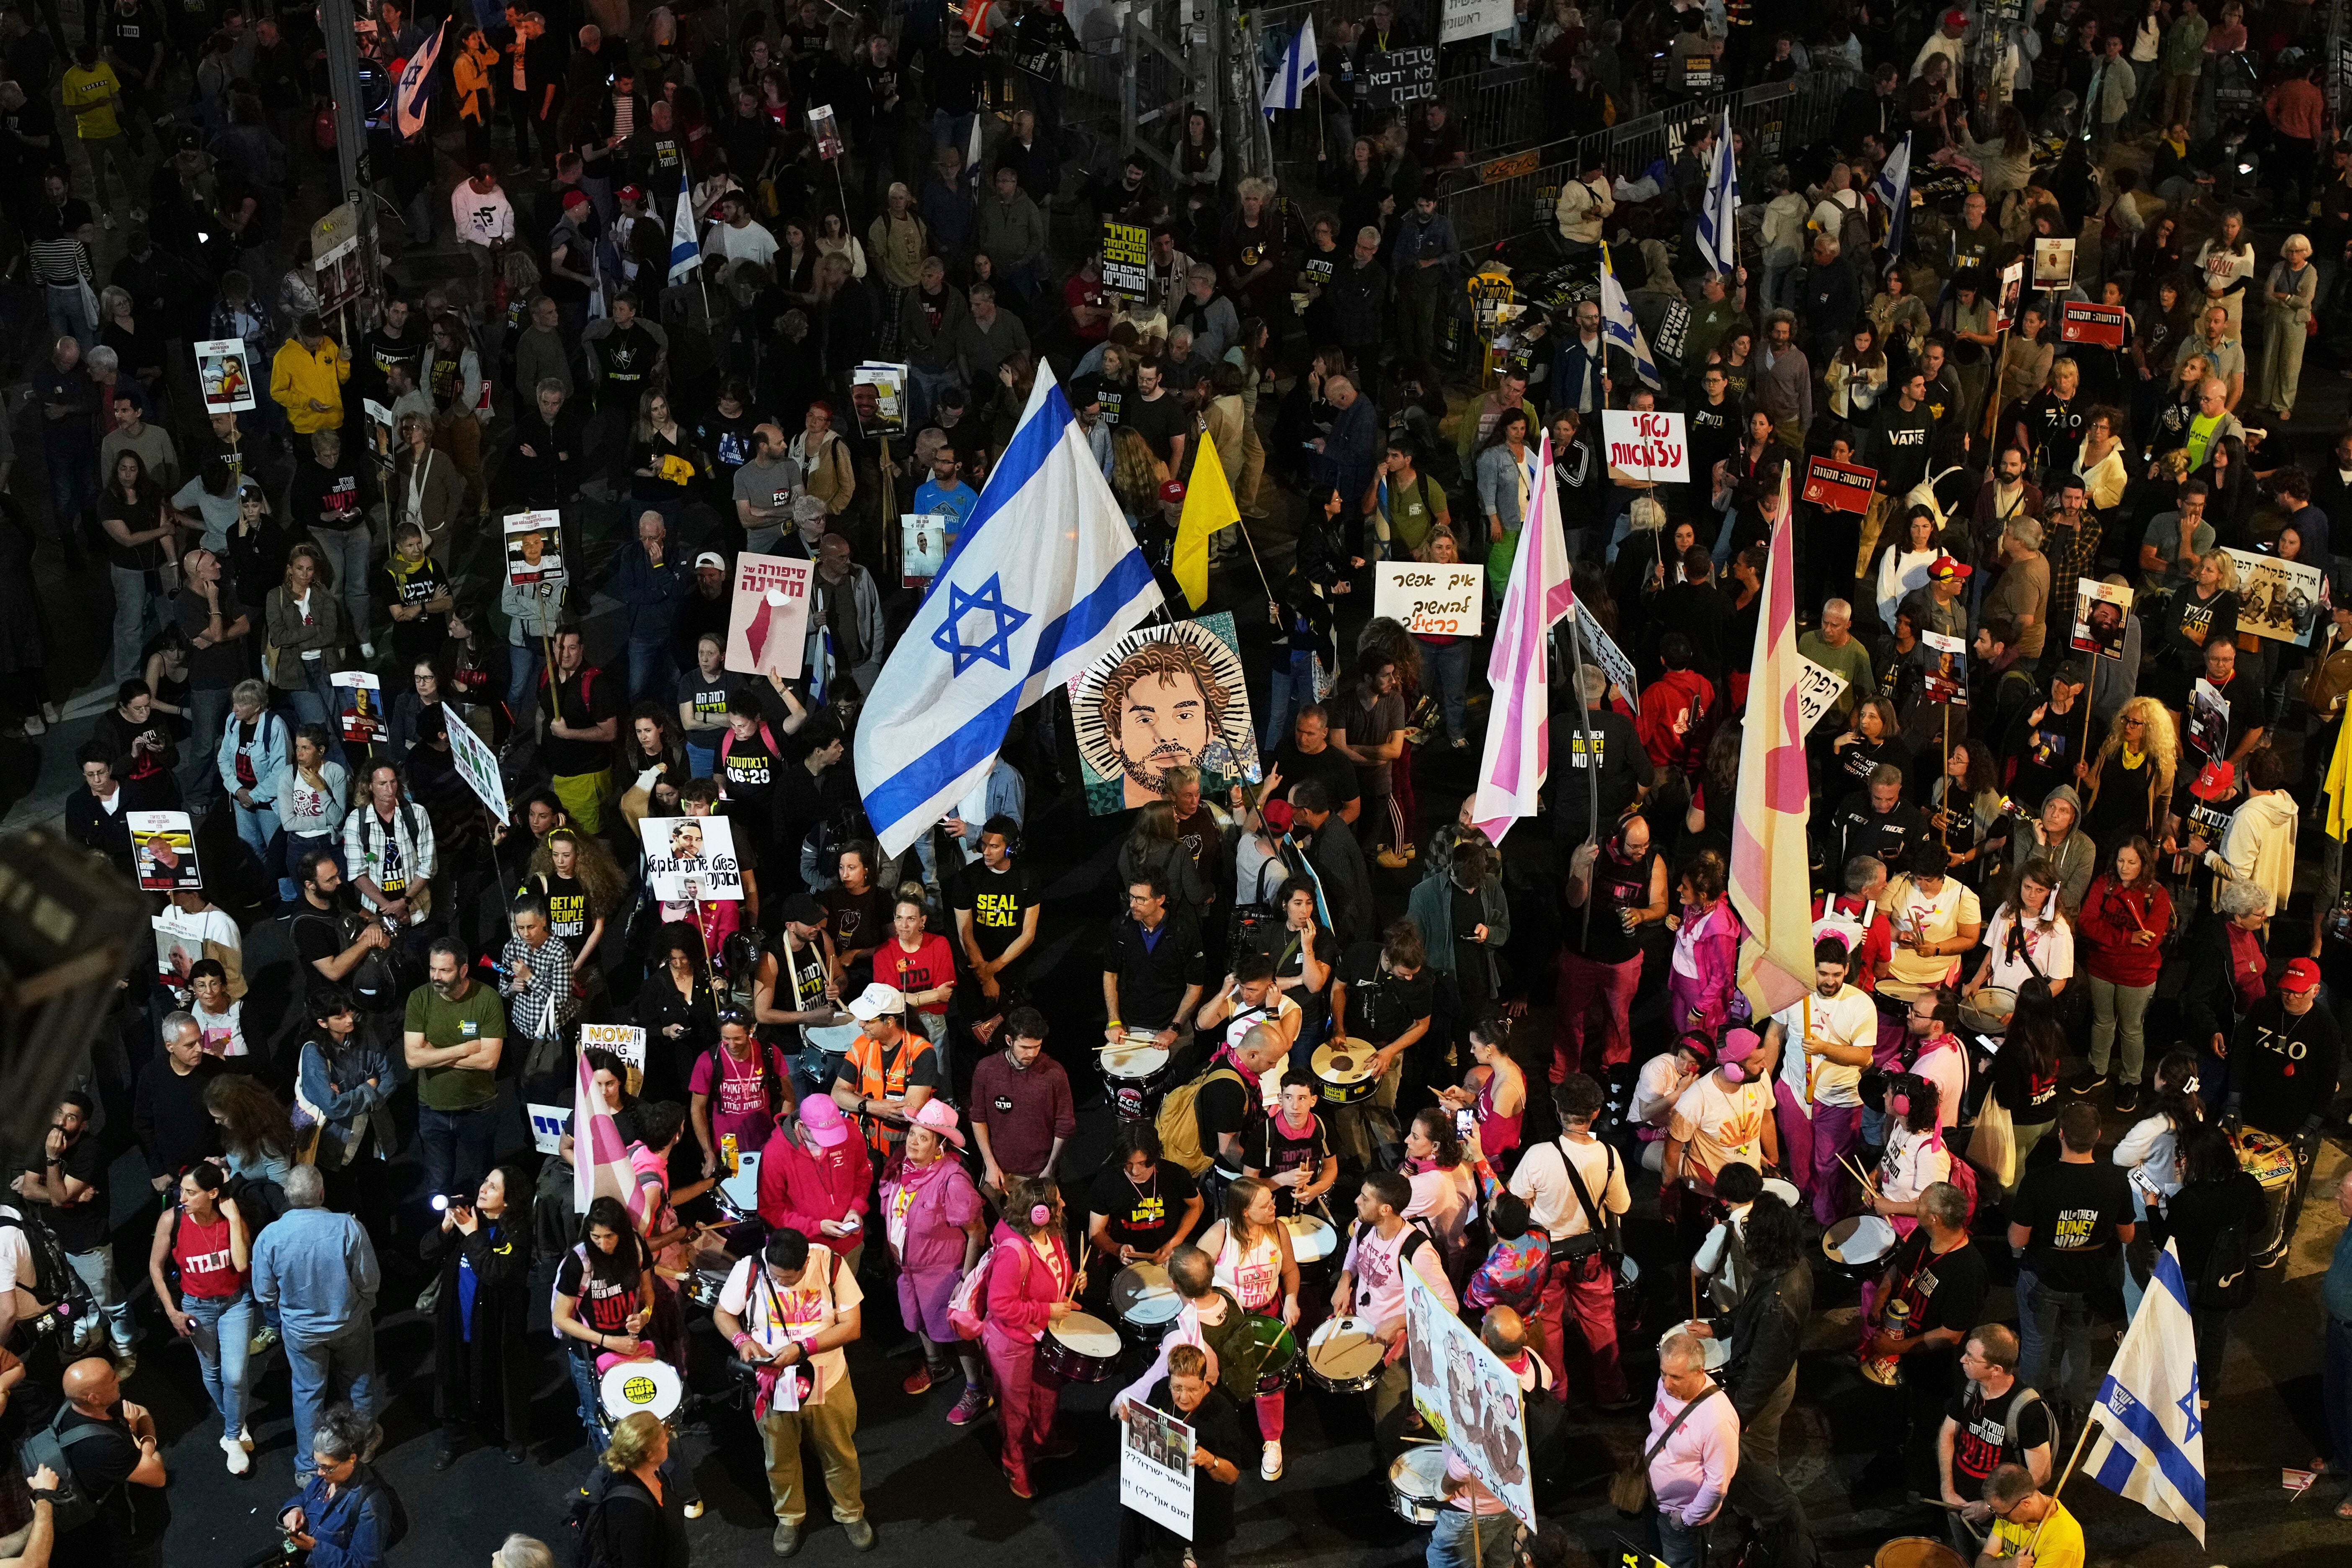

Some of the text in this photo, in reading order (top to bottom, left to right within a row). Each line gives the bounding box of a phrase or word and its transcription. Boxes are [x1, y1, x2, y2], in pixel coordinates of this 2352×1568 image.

[1392, 47, 1433, 67] טבח
[1415, 65, 1433, 80] לא
[1392, 83, 1432, 103] טבח
[1104, 223, 1146, 243] מחיר
[1104, 238, 1146, 253] המלחמה
[1104, 248, 1145, 265] שלכם:
[1104, 261, 1145, 276] חייהם של
[1103, 270, 1145, 291] החטופים!
[2068, 310, 2121, 325] דרושה: תקווה
[1657, 302, 1680, 352] SPILLED?
[1098, 391, 1122, 403] למה הם
[1100, 402, 1120, 413] עדיי
[1888, 430, 1925, 446] VANS
[1813, 466, 1872, 489] דרושה: תקווה
[739, 563, 803, 579] סיפורה של
[2255, 563, 2316, 586] ארץ מפקירי
[1393, 574, 1436, 588] אפשר
[2075, 630, 2084, 638] HIM
[2076, 623, 2090, 632] BRING
[1925, 676, 1936, 684] BRING
[696, 690, 725, 704] למה הם
[2192, 719, 2204, 732] BRING
[1572, 740, 1604, 753] HOE!
[1572, 753, 1603, 768] NO!
[727, 767, 770, 784] 06:29
[1848, 813, 1906, 834] IRON RIDE
[139, 862, 155, 871] BRING
[550, 895, 584, 910] GET MY
[977, 894, 1019, 910] SEAL
[551, 909, 584, 923] PEOPLE
[977, 910, 1016, 927] DEAL
[551, 921, 583, 937] HOME!
[1118, 1103, 1140, 1114] BNGVR
[1119, 1095, 1142, 1109] FCK
[2059, 1210, 2073, 1221] ALL
[2077, 1209, 2099, 1221] THEM
[2056, 1220, 2095, 1236] HOME!
[591, 1283, 623, 1299] THEM HOME
[1243, 1282, 1271, 1294] דורש
[624, 1385, 655, 1397] אשם
[1982, 1417, 2005, 1437] מחזירים
[1986, 1431, 2004, 1447] אותם
[1166, 1472, 1191, 1492] והשאר
[1171, 1504, 1191, 1520] זמנם
